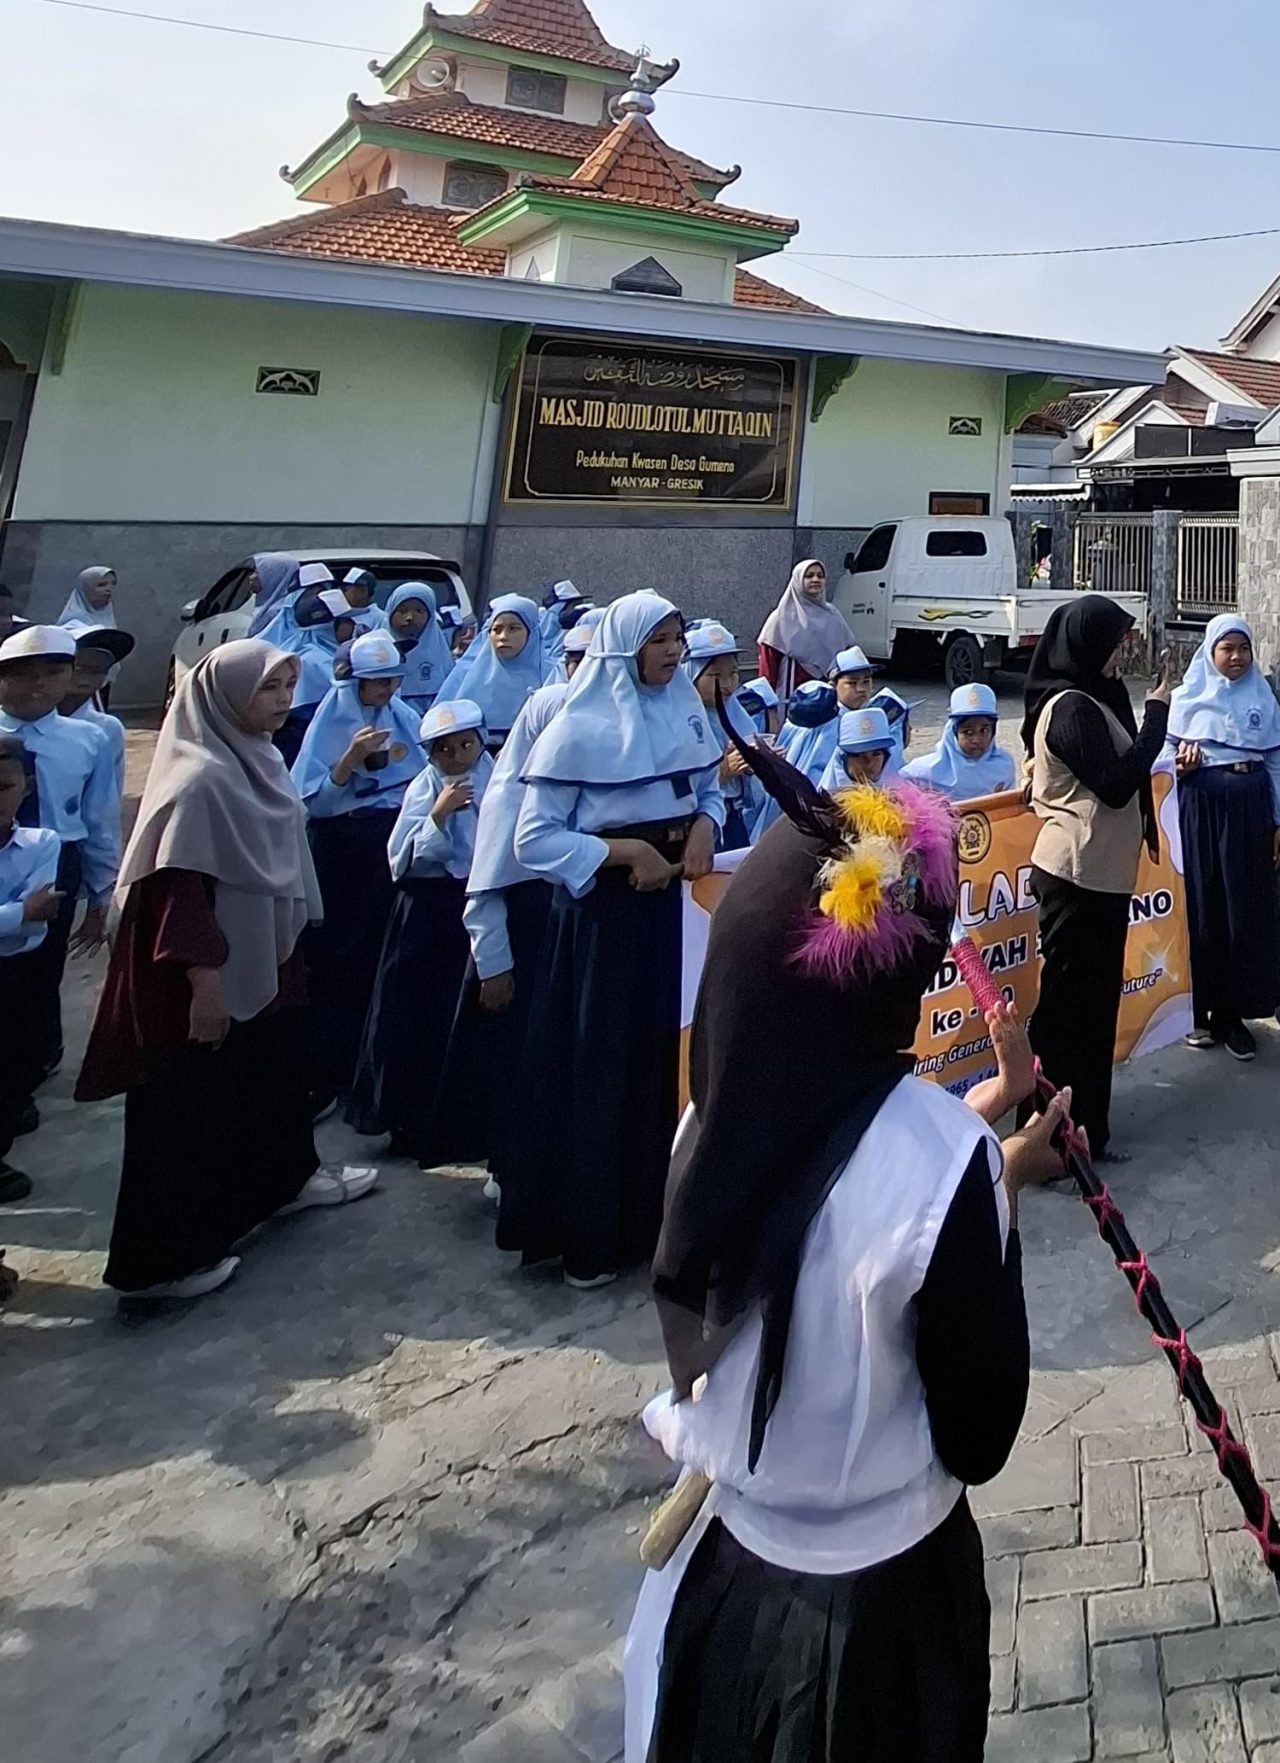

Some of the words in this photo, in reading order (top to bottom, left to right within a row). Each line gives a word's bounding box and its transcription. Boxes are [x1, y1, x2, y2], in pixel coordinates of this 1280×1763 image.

[539, 397, 604, 428] MASJID
[605, 401, 691, 433] ROUDLOTUL
[692, 407, 772, 437] MUTTAQIN
[576, 450, 629, 468] Pedukuhan
[632, 452, 667, 470] Kwasen
[670, 454, 696, 471] Desa
[699, 455, 735, 473] Gumeno
[611, 476, 659, 488] MANYAR
[667, 478, 703, 490] GRESIK
[931, 1010, 962, 1036] ke
